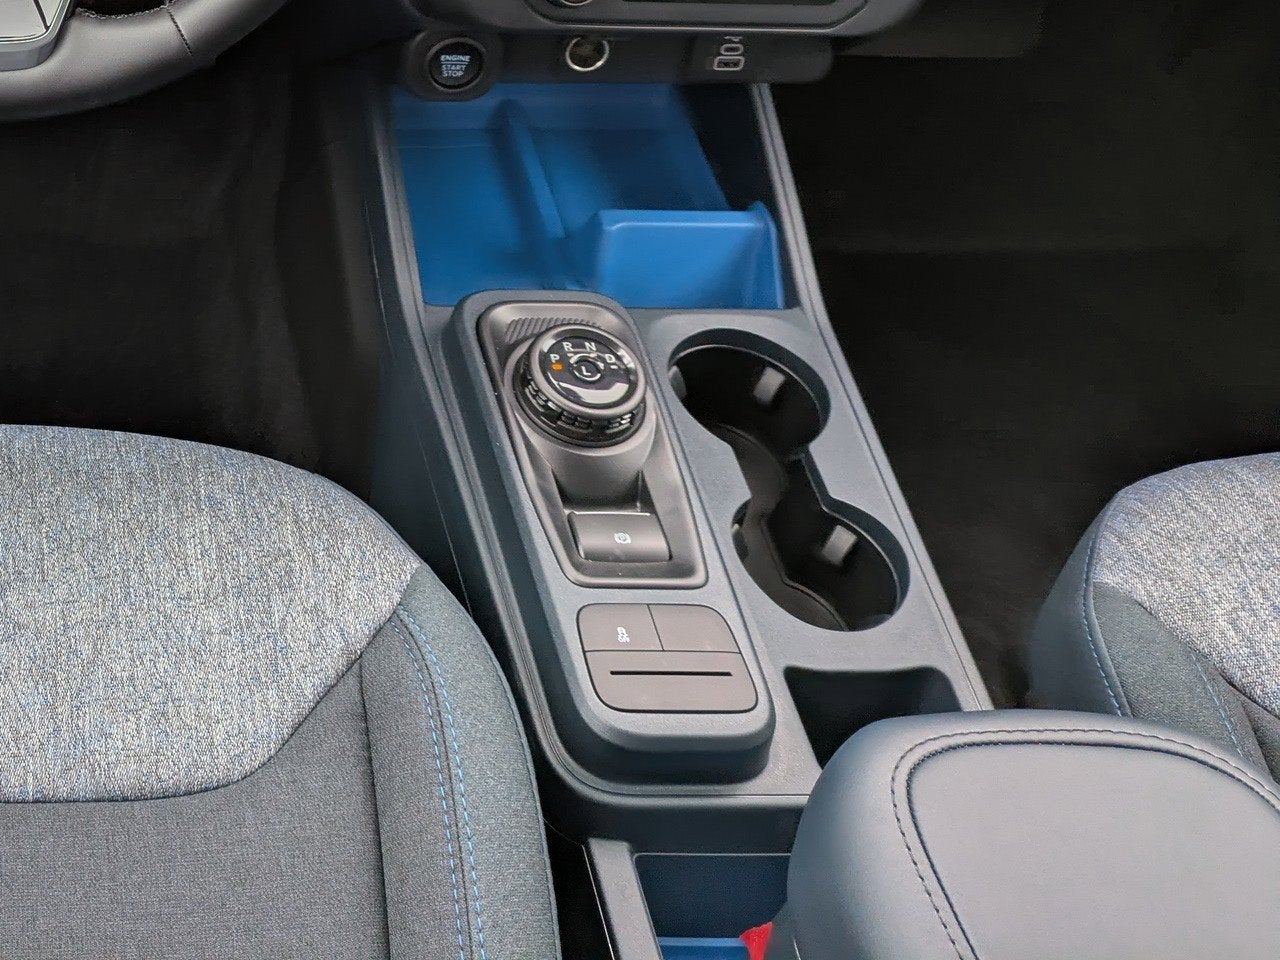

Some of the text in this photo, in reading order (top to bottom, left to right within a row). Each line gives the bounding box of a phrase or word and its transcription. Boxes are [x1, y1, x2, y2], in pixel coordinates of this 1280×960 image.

[440, 54, 471, 62] ENGINE
[441, 64, 467, 72] START
[562, 341, 597, 352] R N
[550, 353, 616, 363] P D
[581, 366, 591, 376] L
